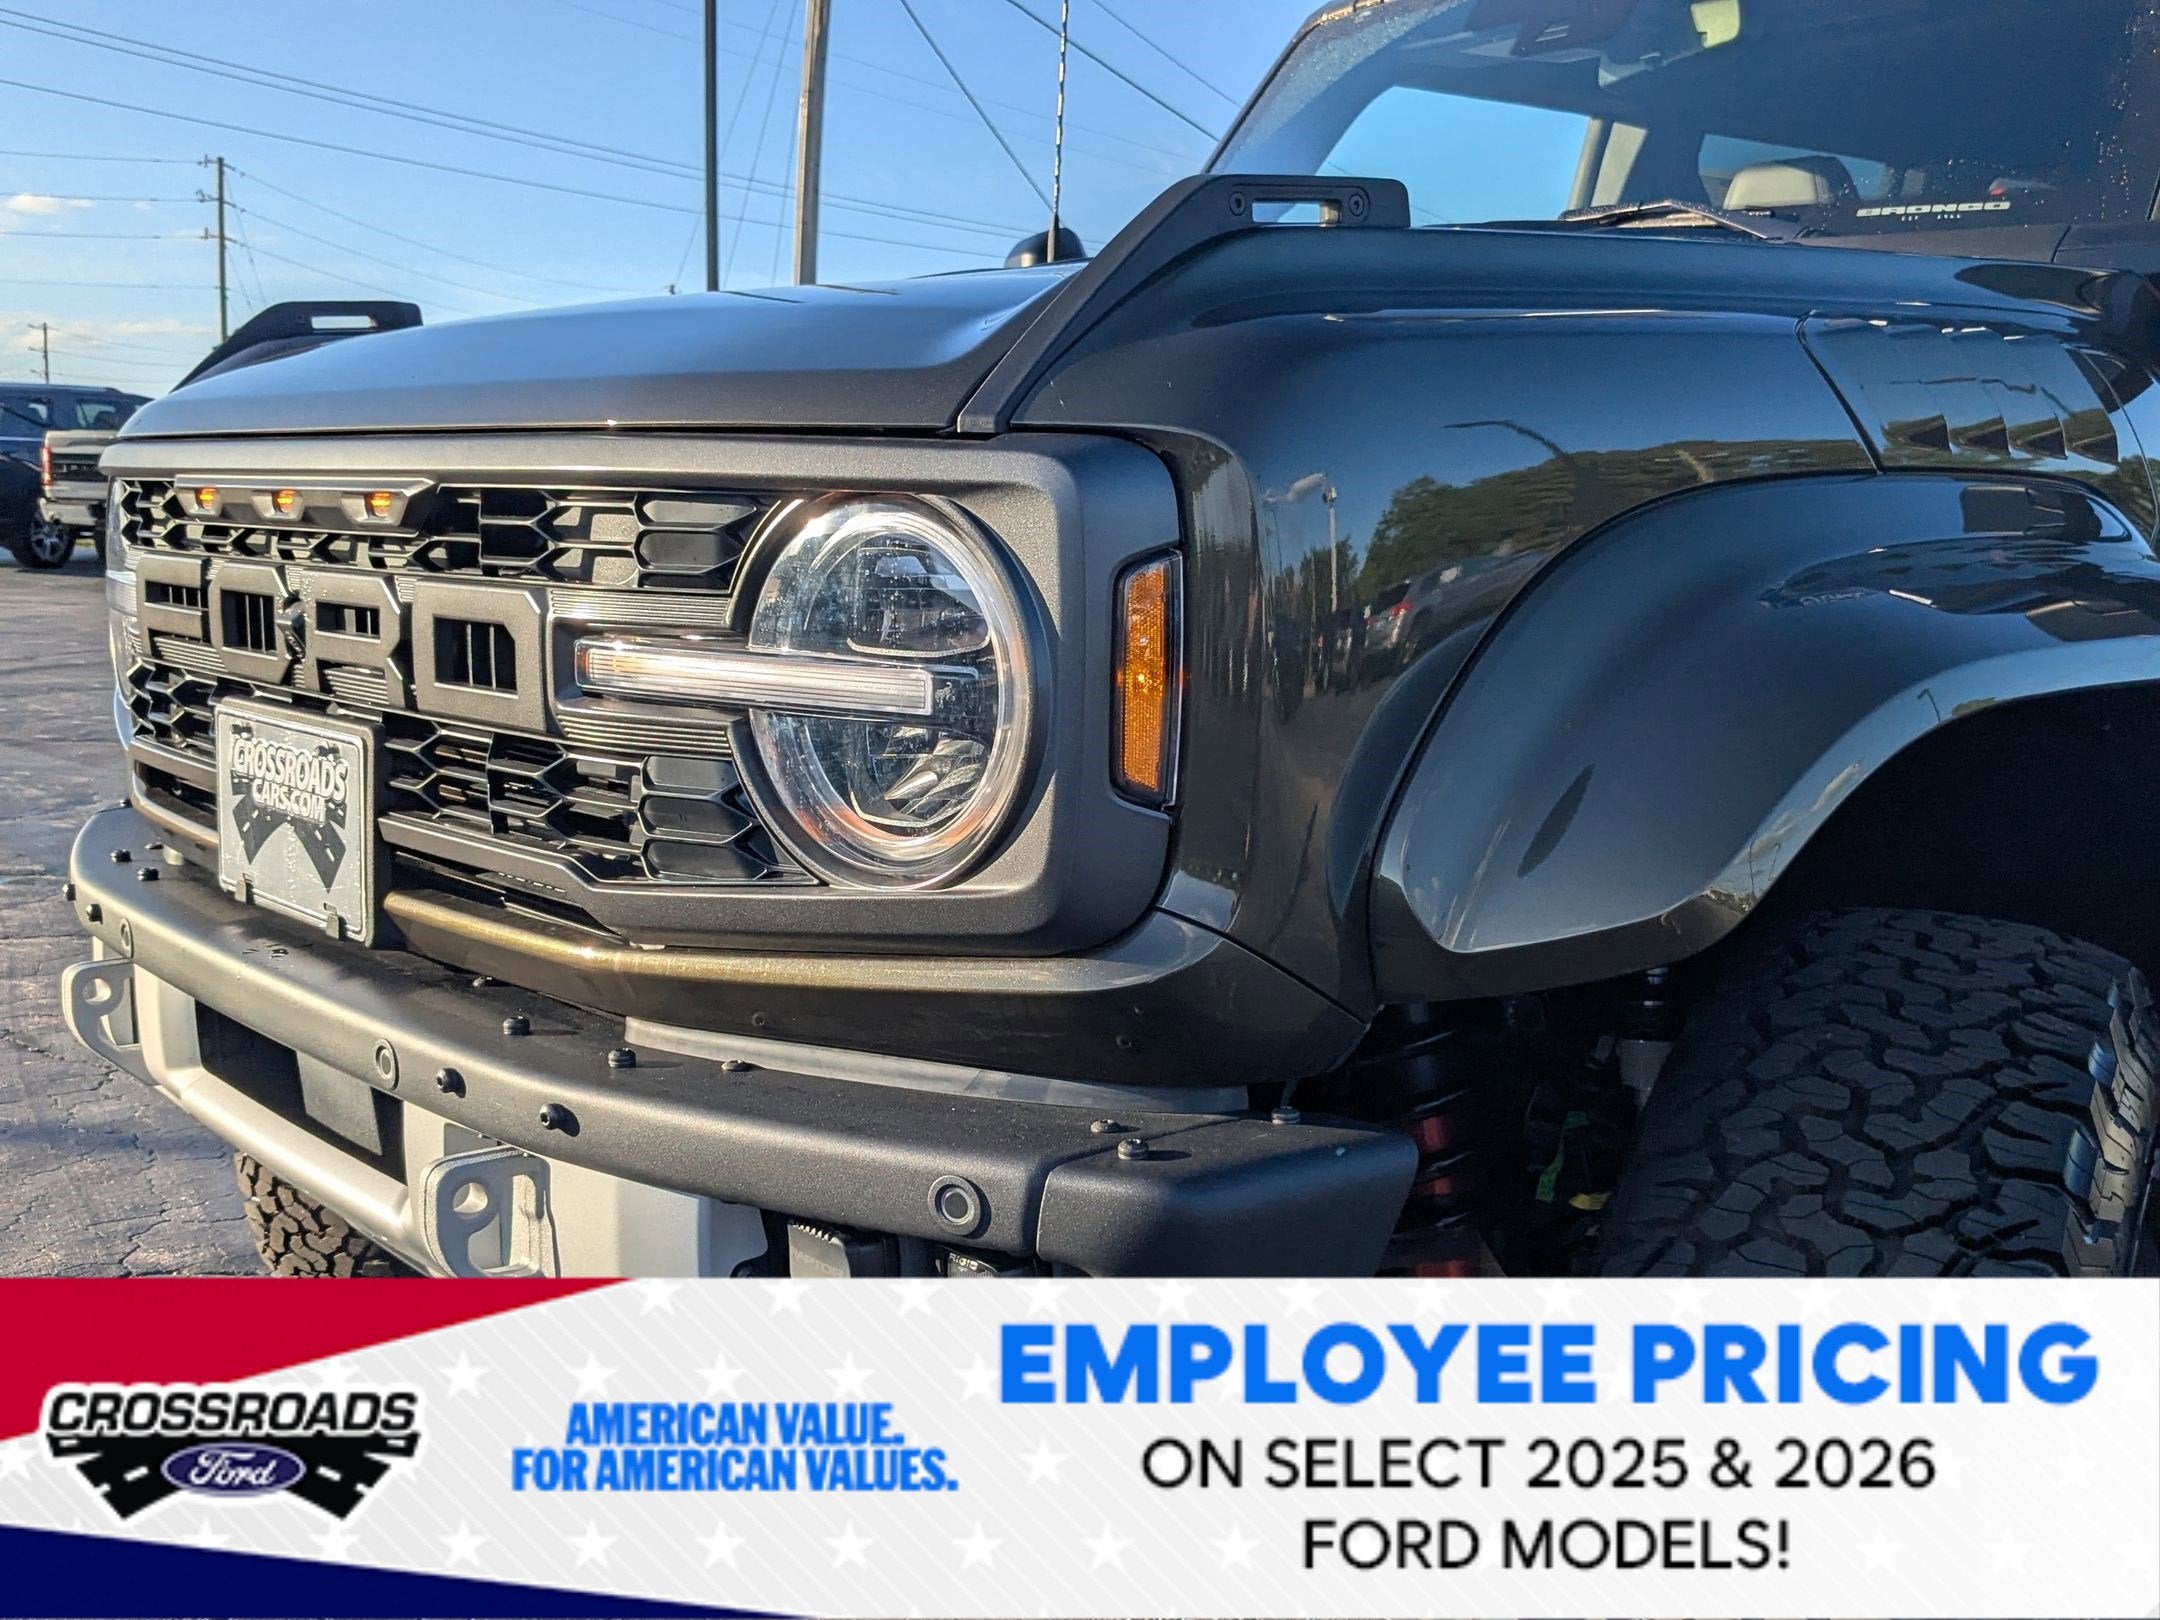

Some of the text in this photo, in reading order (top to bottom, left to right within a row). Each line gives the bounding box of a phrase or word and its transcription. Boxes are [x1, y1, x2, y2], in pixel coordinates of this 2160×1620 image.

[1856, 201, 2011, 217] BRONCO
[136, 552, 548, 732] FORD
[232, 738, 348, 802] CROSSROADS
[252, 779, 326, 824] CARS.COM
